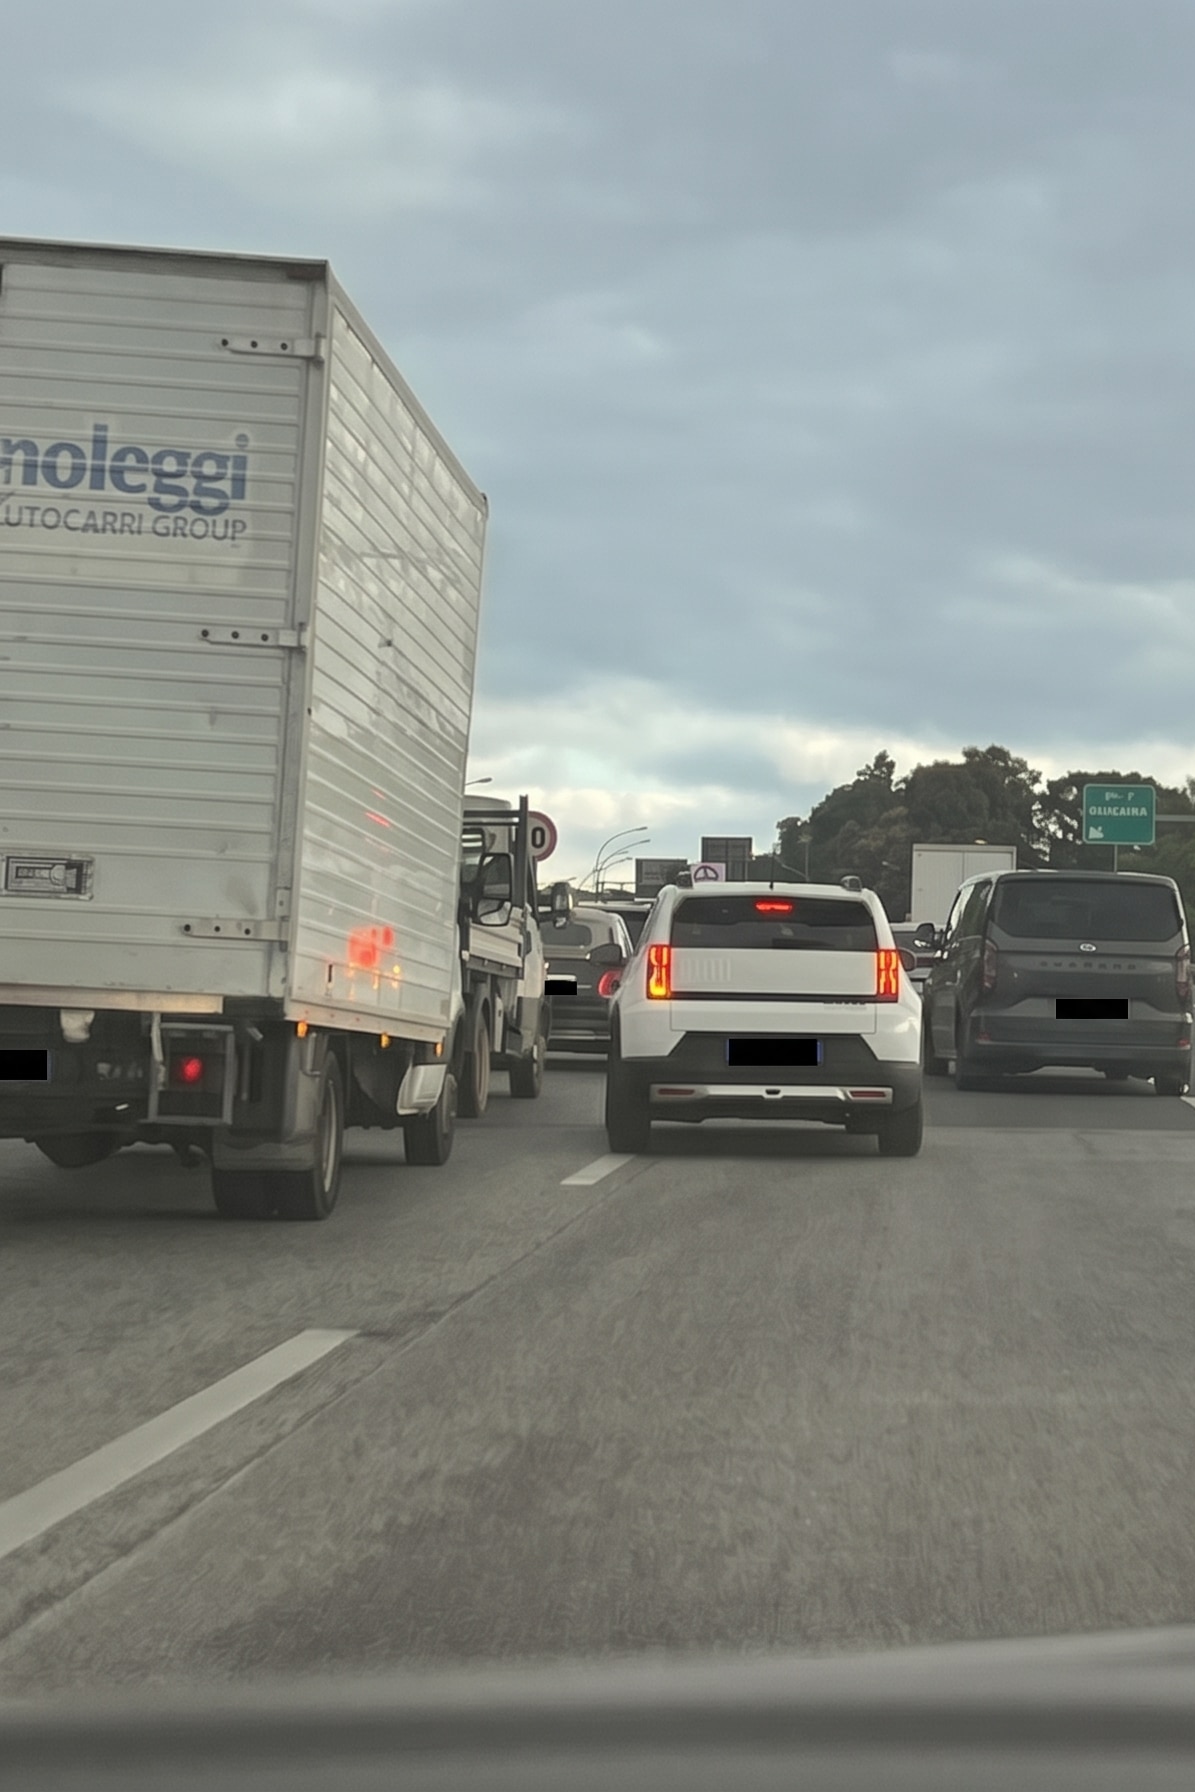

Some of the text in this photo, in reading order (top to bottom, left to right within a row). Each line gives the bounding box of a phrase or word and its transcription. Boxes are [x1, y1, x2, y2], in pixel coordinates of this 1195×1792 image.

[0, 423, 249, 516] noleggi
[0, 504, 247, 541] UTOCARRI GROUP
